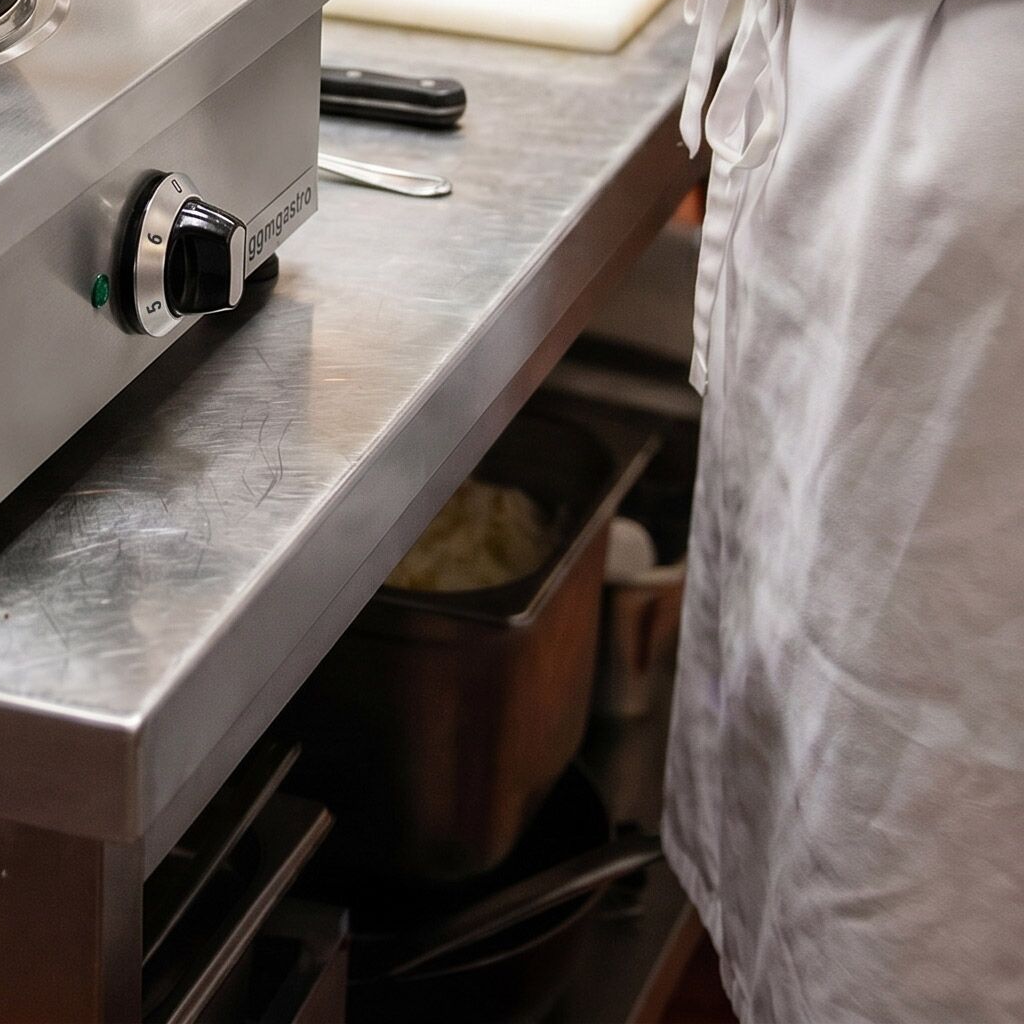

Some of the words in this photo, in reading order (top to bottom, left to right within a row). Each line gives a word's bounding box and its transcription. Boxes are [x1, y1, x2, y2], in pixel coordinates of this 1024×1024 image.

[248, 187, 312, 261] ggmgastro
[147, 232, 163, 245] 6
[146, 300, 162, 314] 5
